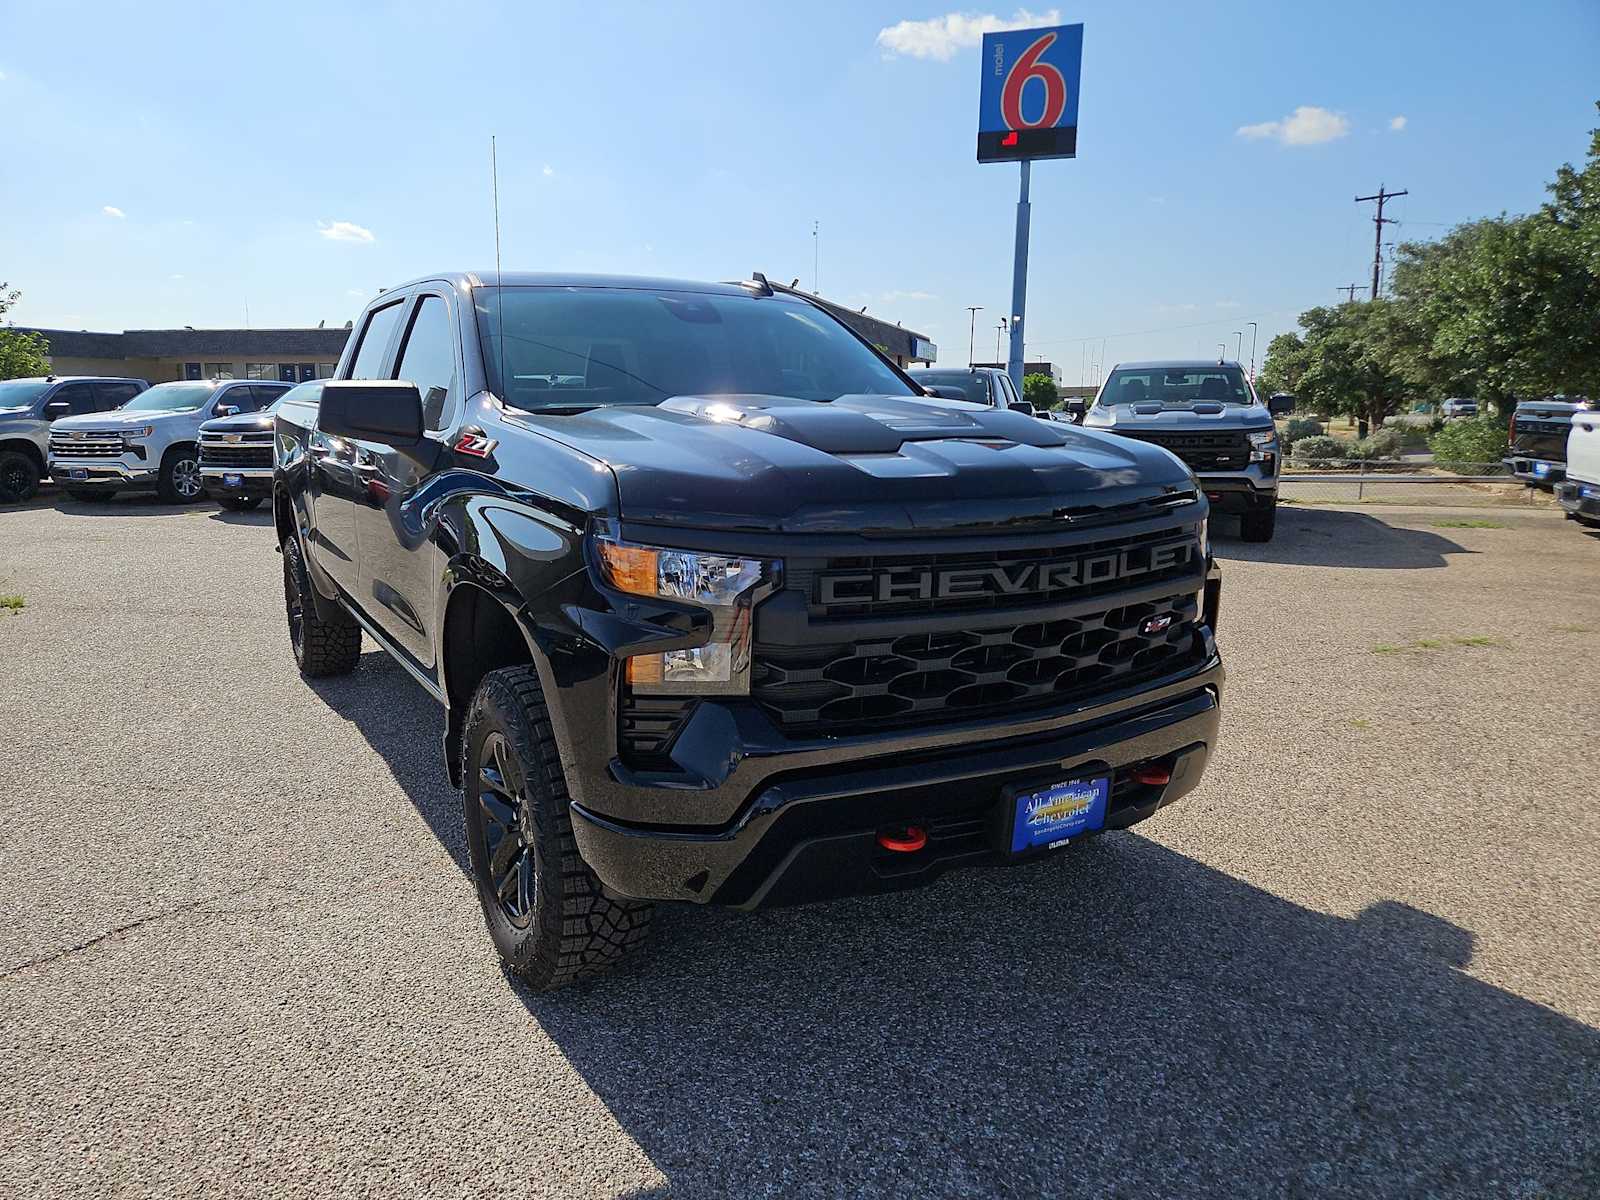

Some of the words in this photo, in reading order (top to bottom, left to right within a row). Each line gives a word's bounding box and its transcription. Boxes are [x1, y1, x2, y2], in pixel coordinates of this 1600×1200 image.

[1000, 32, 1067, 131] 6
[820, 541, 1199, 603] CHEVROLET
[1025, 797, 1042, 814] All
[1047, 788, 1100, 807] American
[1034, 804, 1089, 826] Chevrolet
